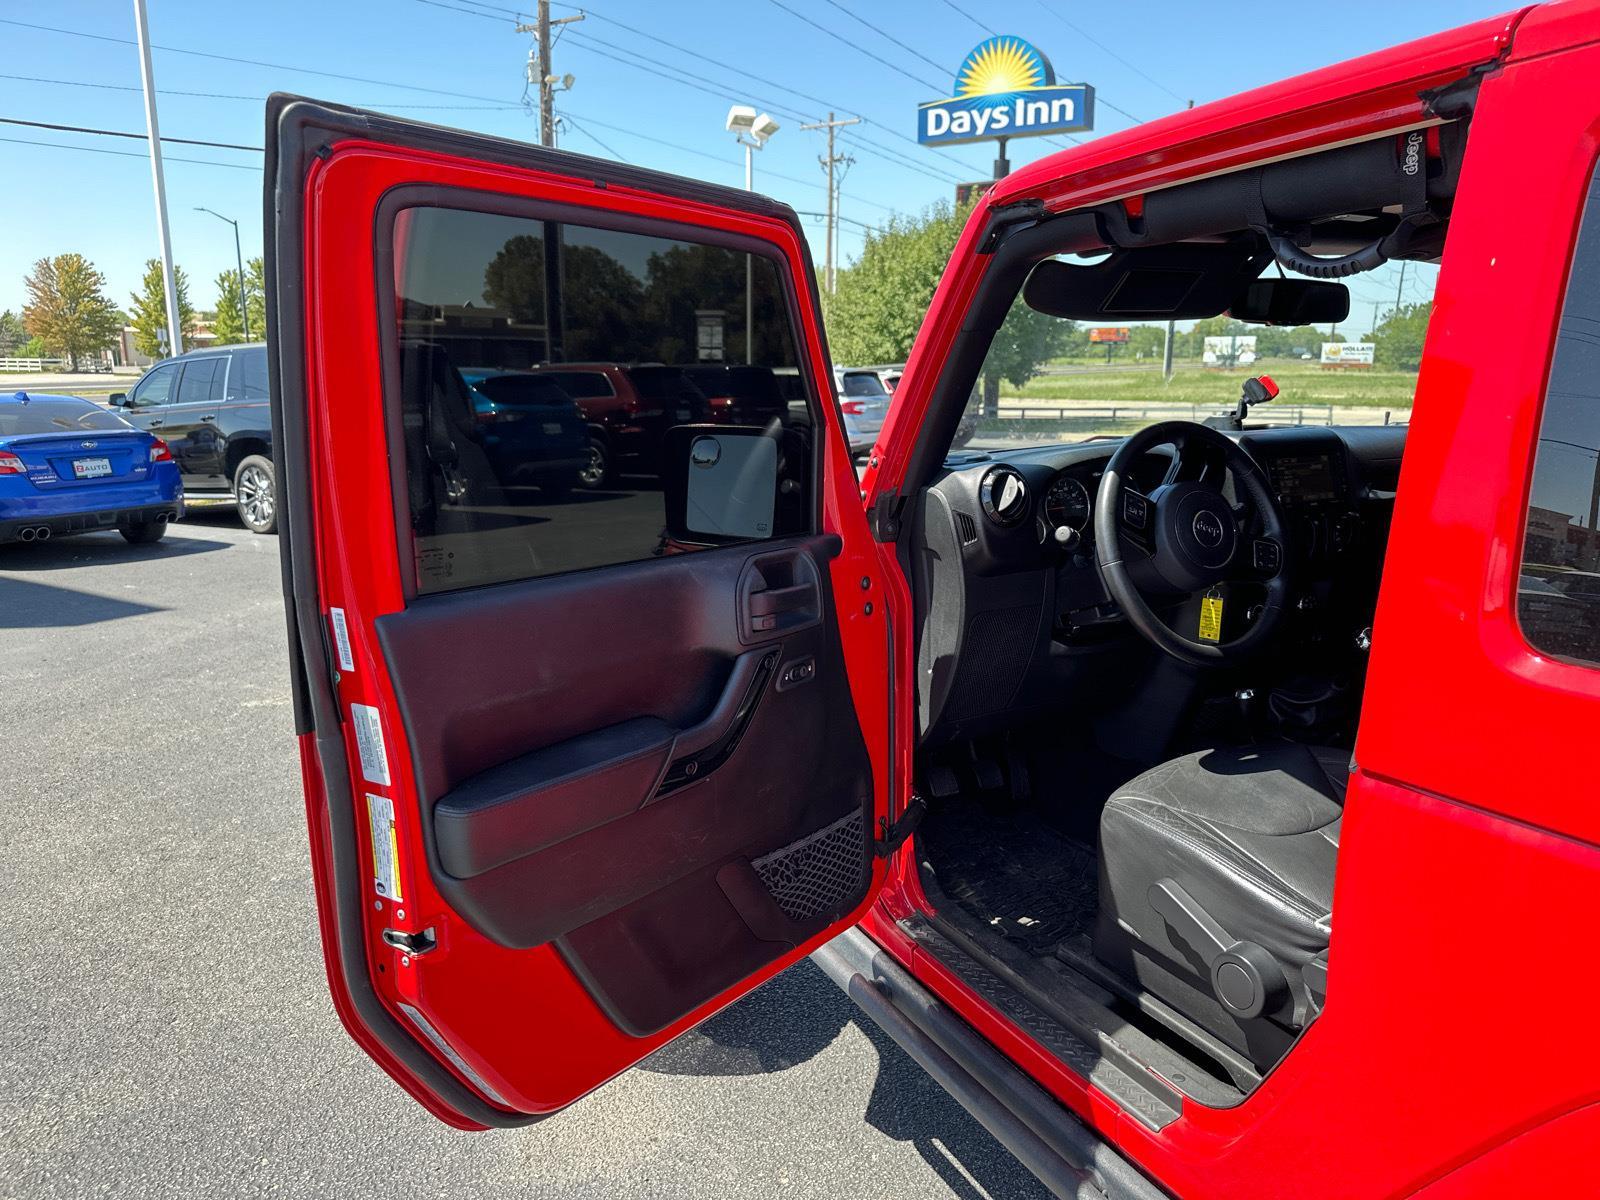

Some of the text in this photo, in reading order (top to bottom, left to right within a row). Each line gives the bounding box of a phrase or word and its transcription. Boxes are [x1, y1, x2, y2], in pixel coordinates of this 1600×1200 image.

[927, 97, 1074, 136] Days Inn
[1403, 132, 1423, 175] Jeep
